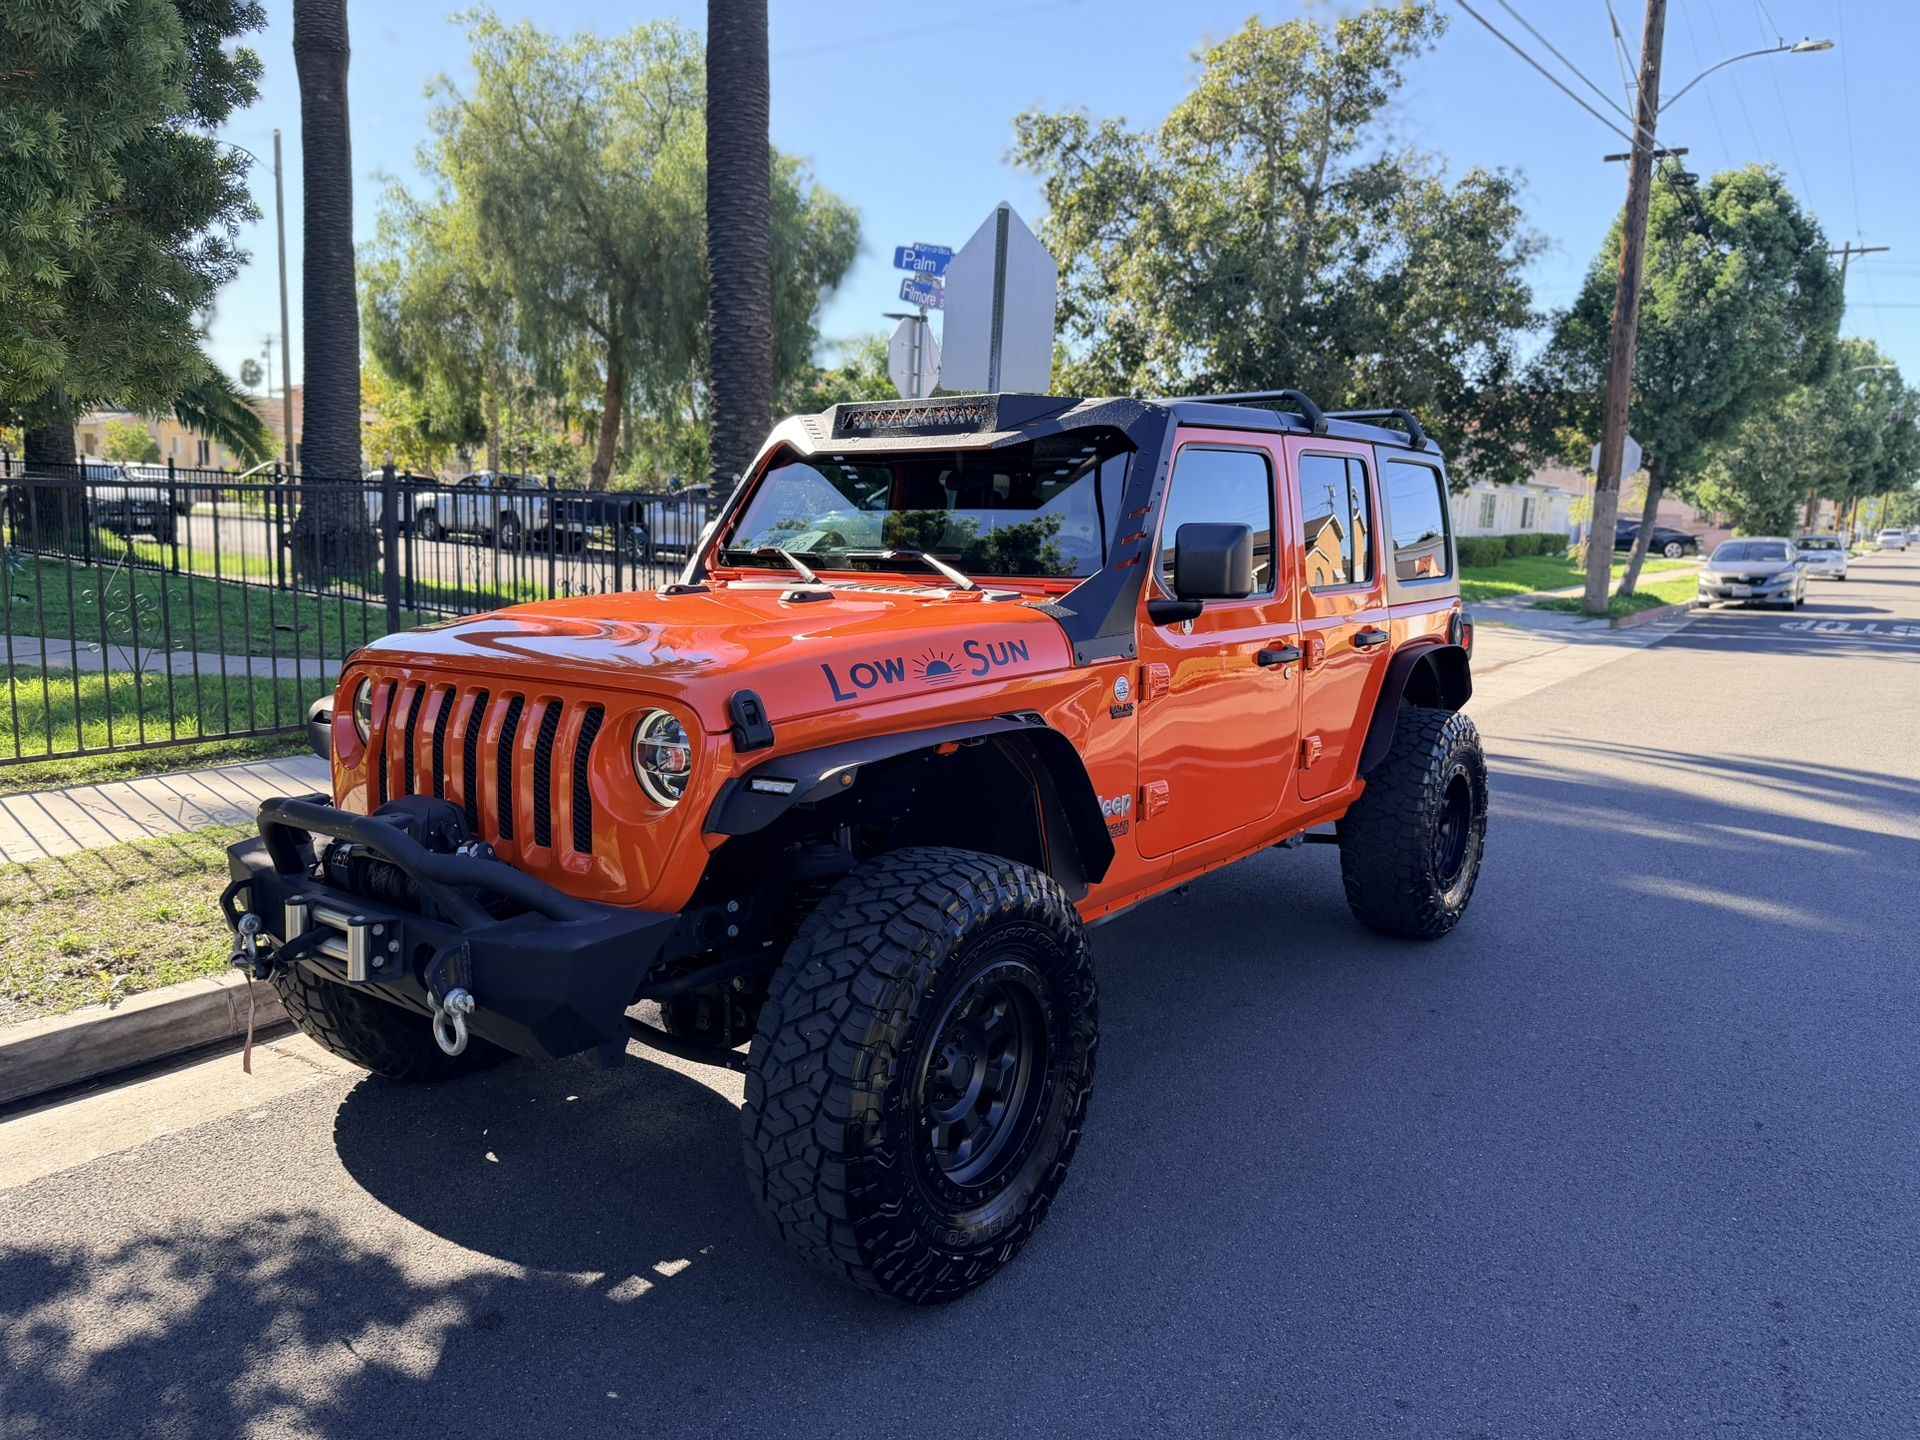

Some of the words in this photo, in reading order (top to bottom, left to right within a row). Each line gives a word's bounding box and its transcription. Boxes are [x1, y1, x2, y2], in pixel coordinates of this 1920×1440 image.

[902, 250, 936, 272] Palm
[902, 281, 936, 307] Filmore
[821, 657, 905, 702] LOW
[963, 639, 1030, 677] SUN
